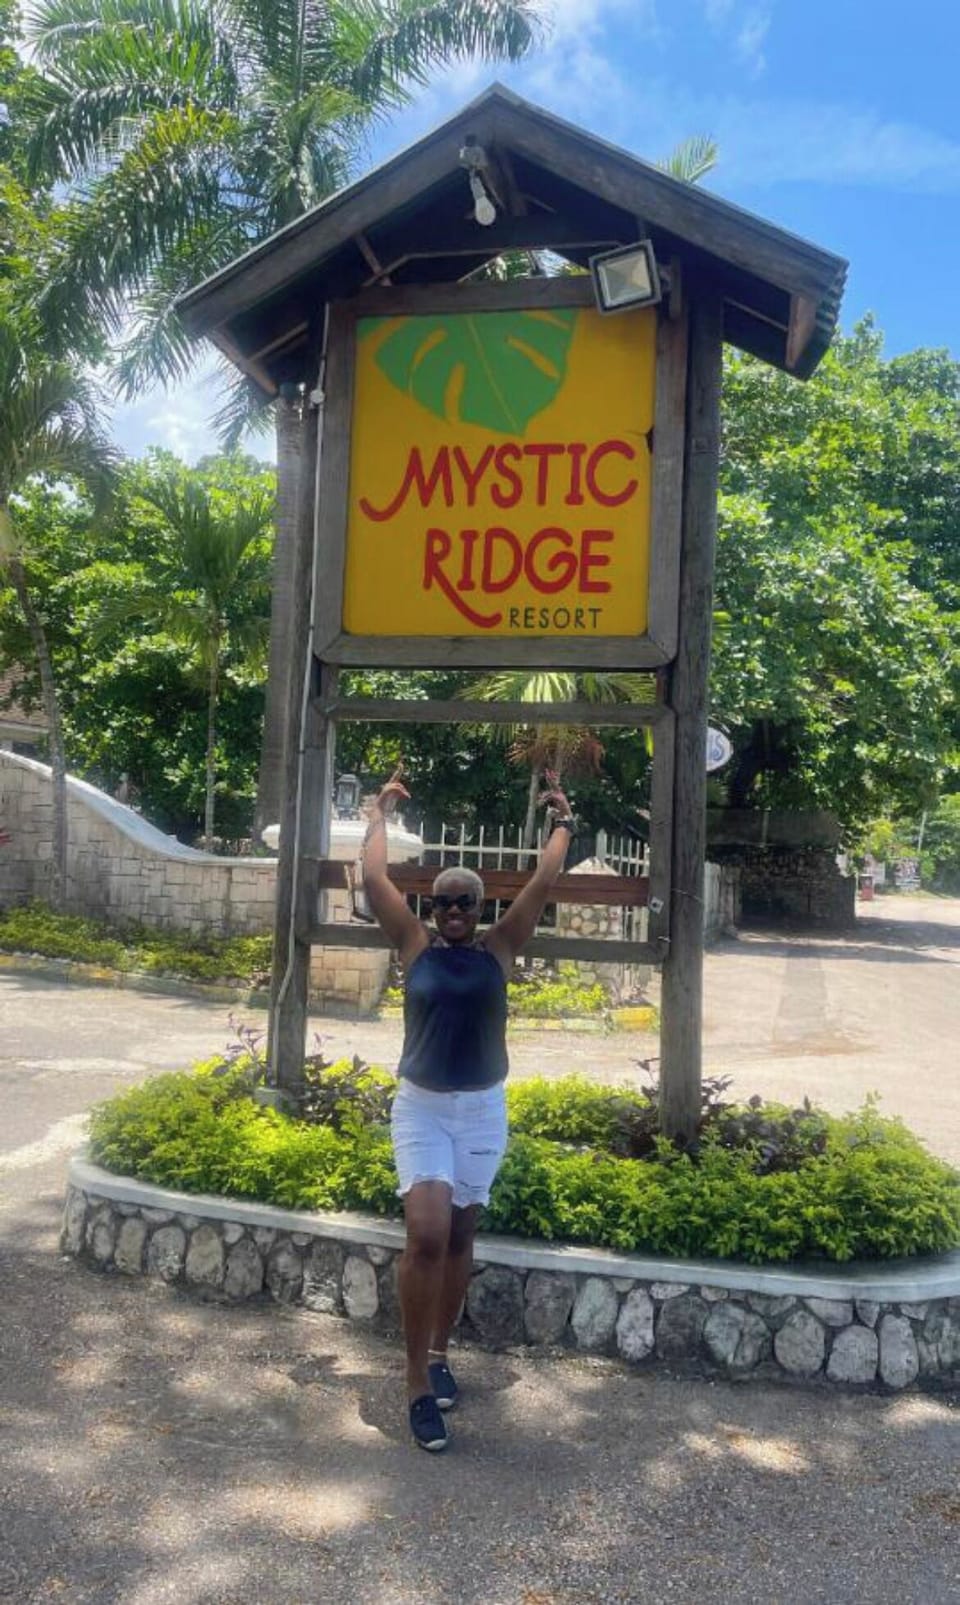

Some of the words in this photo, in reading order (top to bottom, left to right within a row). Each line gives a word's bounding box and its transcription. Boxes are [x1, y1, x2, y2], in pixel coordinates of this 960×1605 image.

[359, 440, 638, 521] MYSTIC
[423, 527, 614, 628] RIDGE
[509, 607, 602, 629] RESORT
